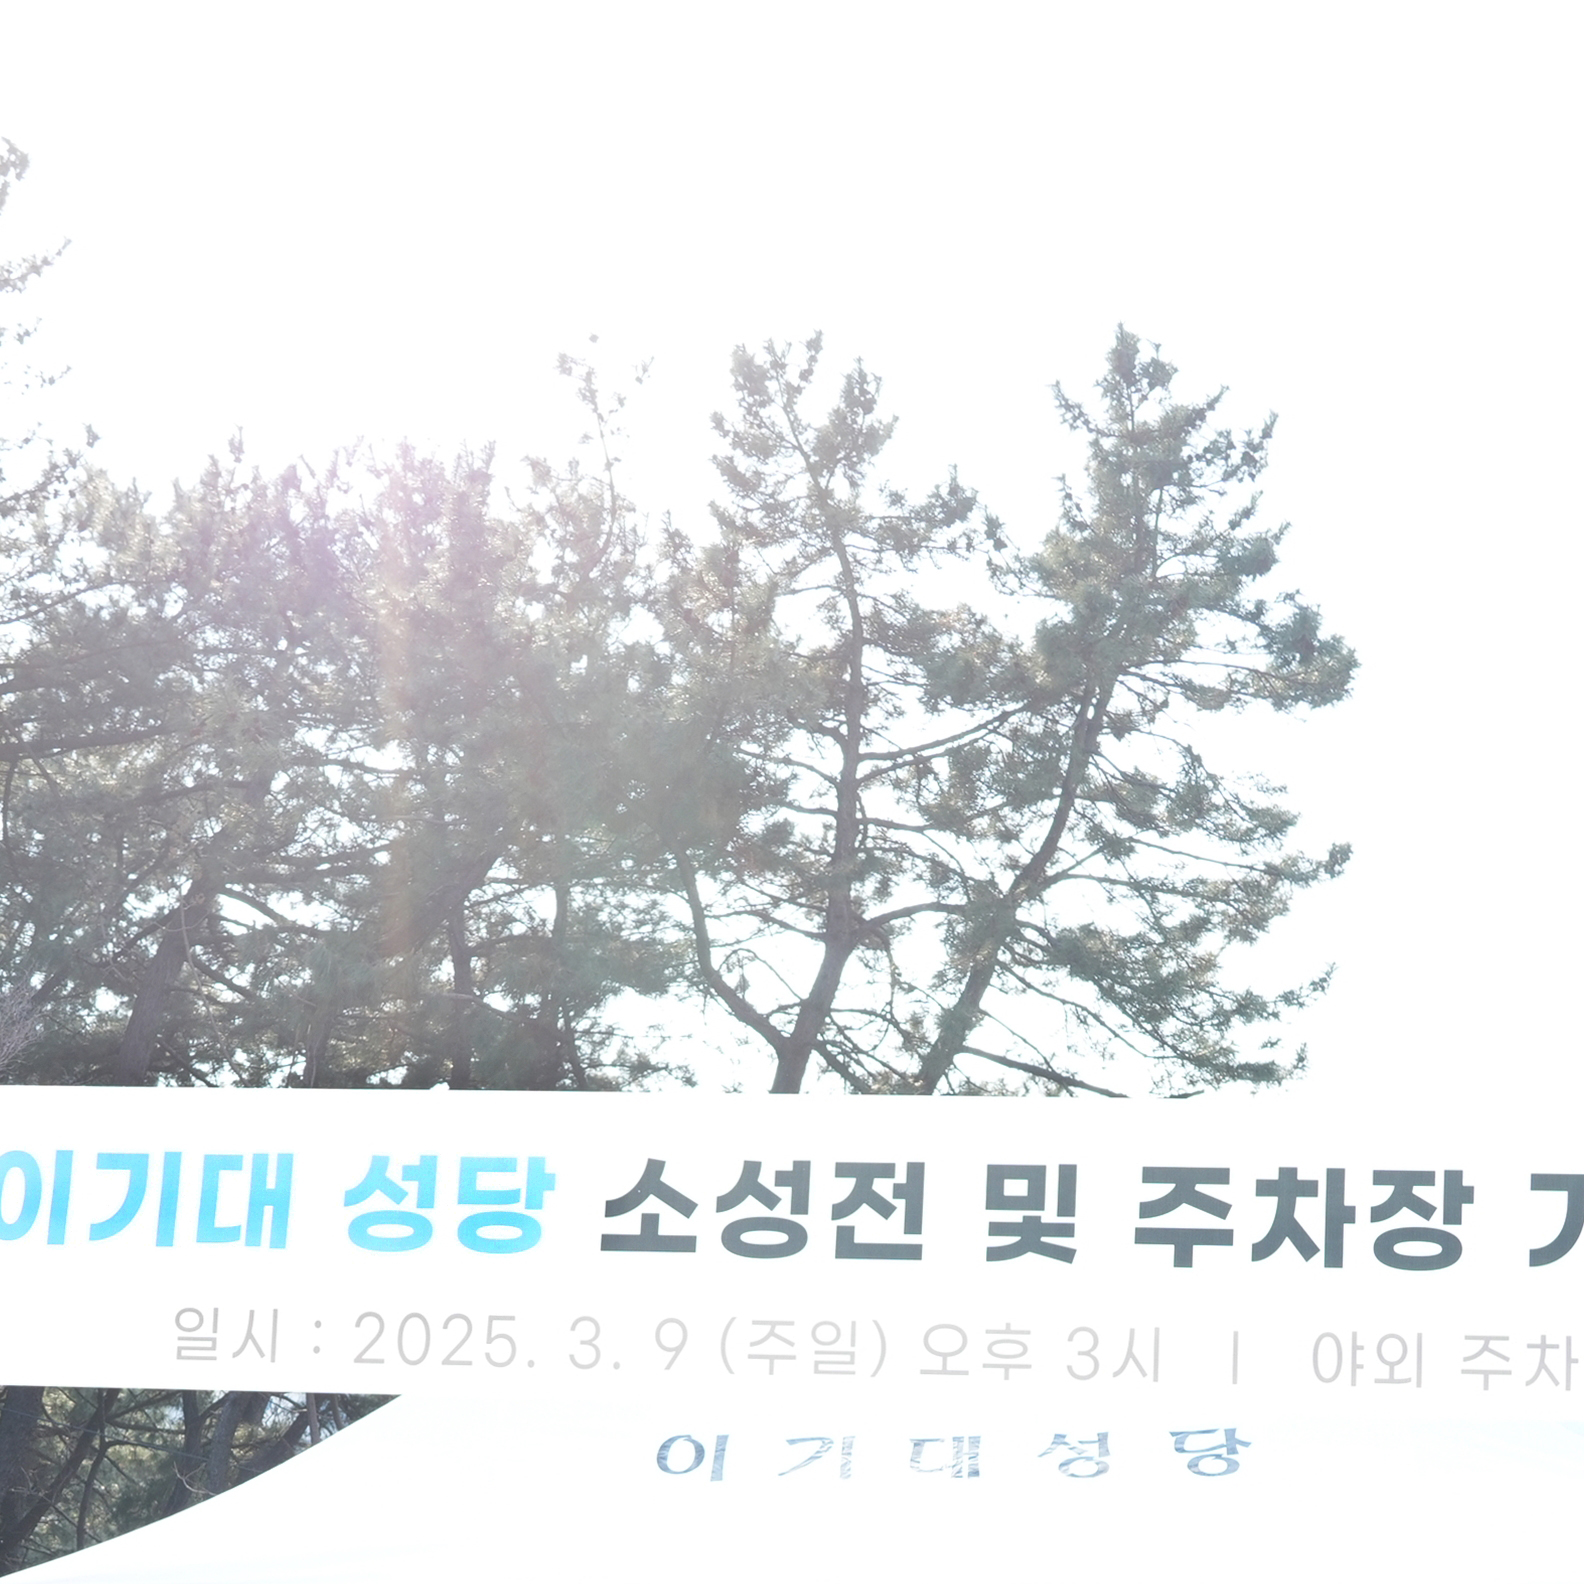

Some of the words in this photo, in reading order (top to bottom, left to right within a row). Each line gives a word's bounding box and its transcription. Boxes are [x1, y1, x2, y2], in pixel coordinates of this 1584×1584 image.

[343, 1154, 558, 1256] 성당
[599, 1157, 927, 1262] 소성전
[984, 1163, 1079, 1266] 및
[1133, 1165, 1476, 1273] 주차장
[174, 1307, 280, 1364] 일시
[353, 1311, 536, 1370] 2025.
[568, 1315, 622, 1371] 3.
[654, 1317, 689, 1372] 9
[719, 1316, 888, 1379] (주일)
[919, 1322, 1034, 1382] 오후
[1066, 1326, 1161, 1384] 3시
[1312, 1331, 1424, 1390] 야외
